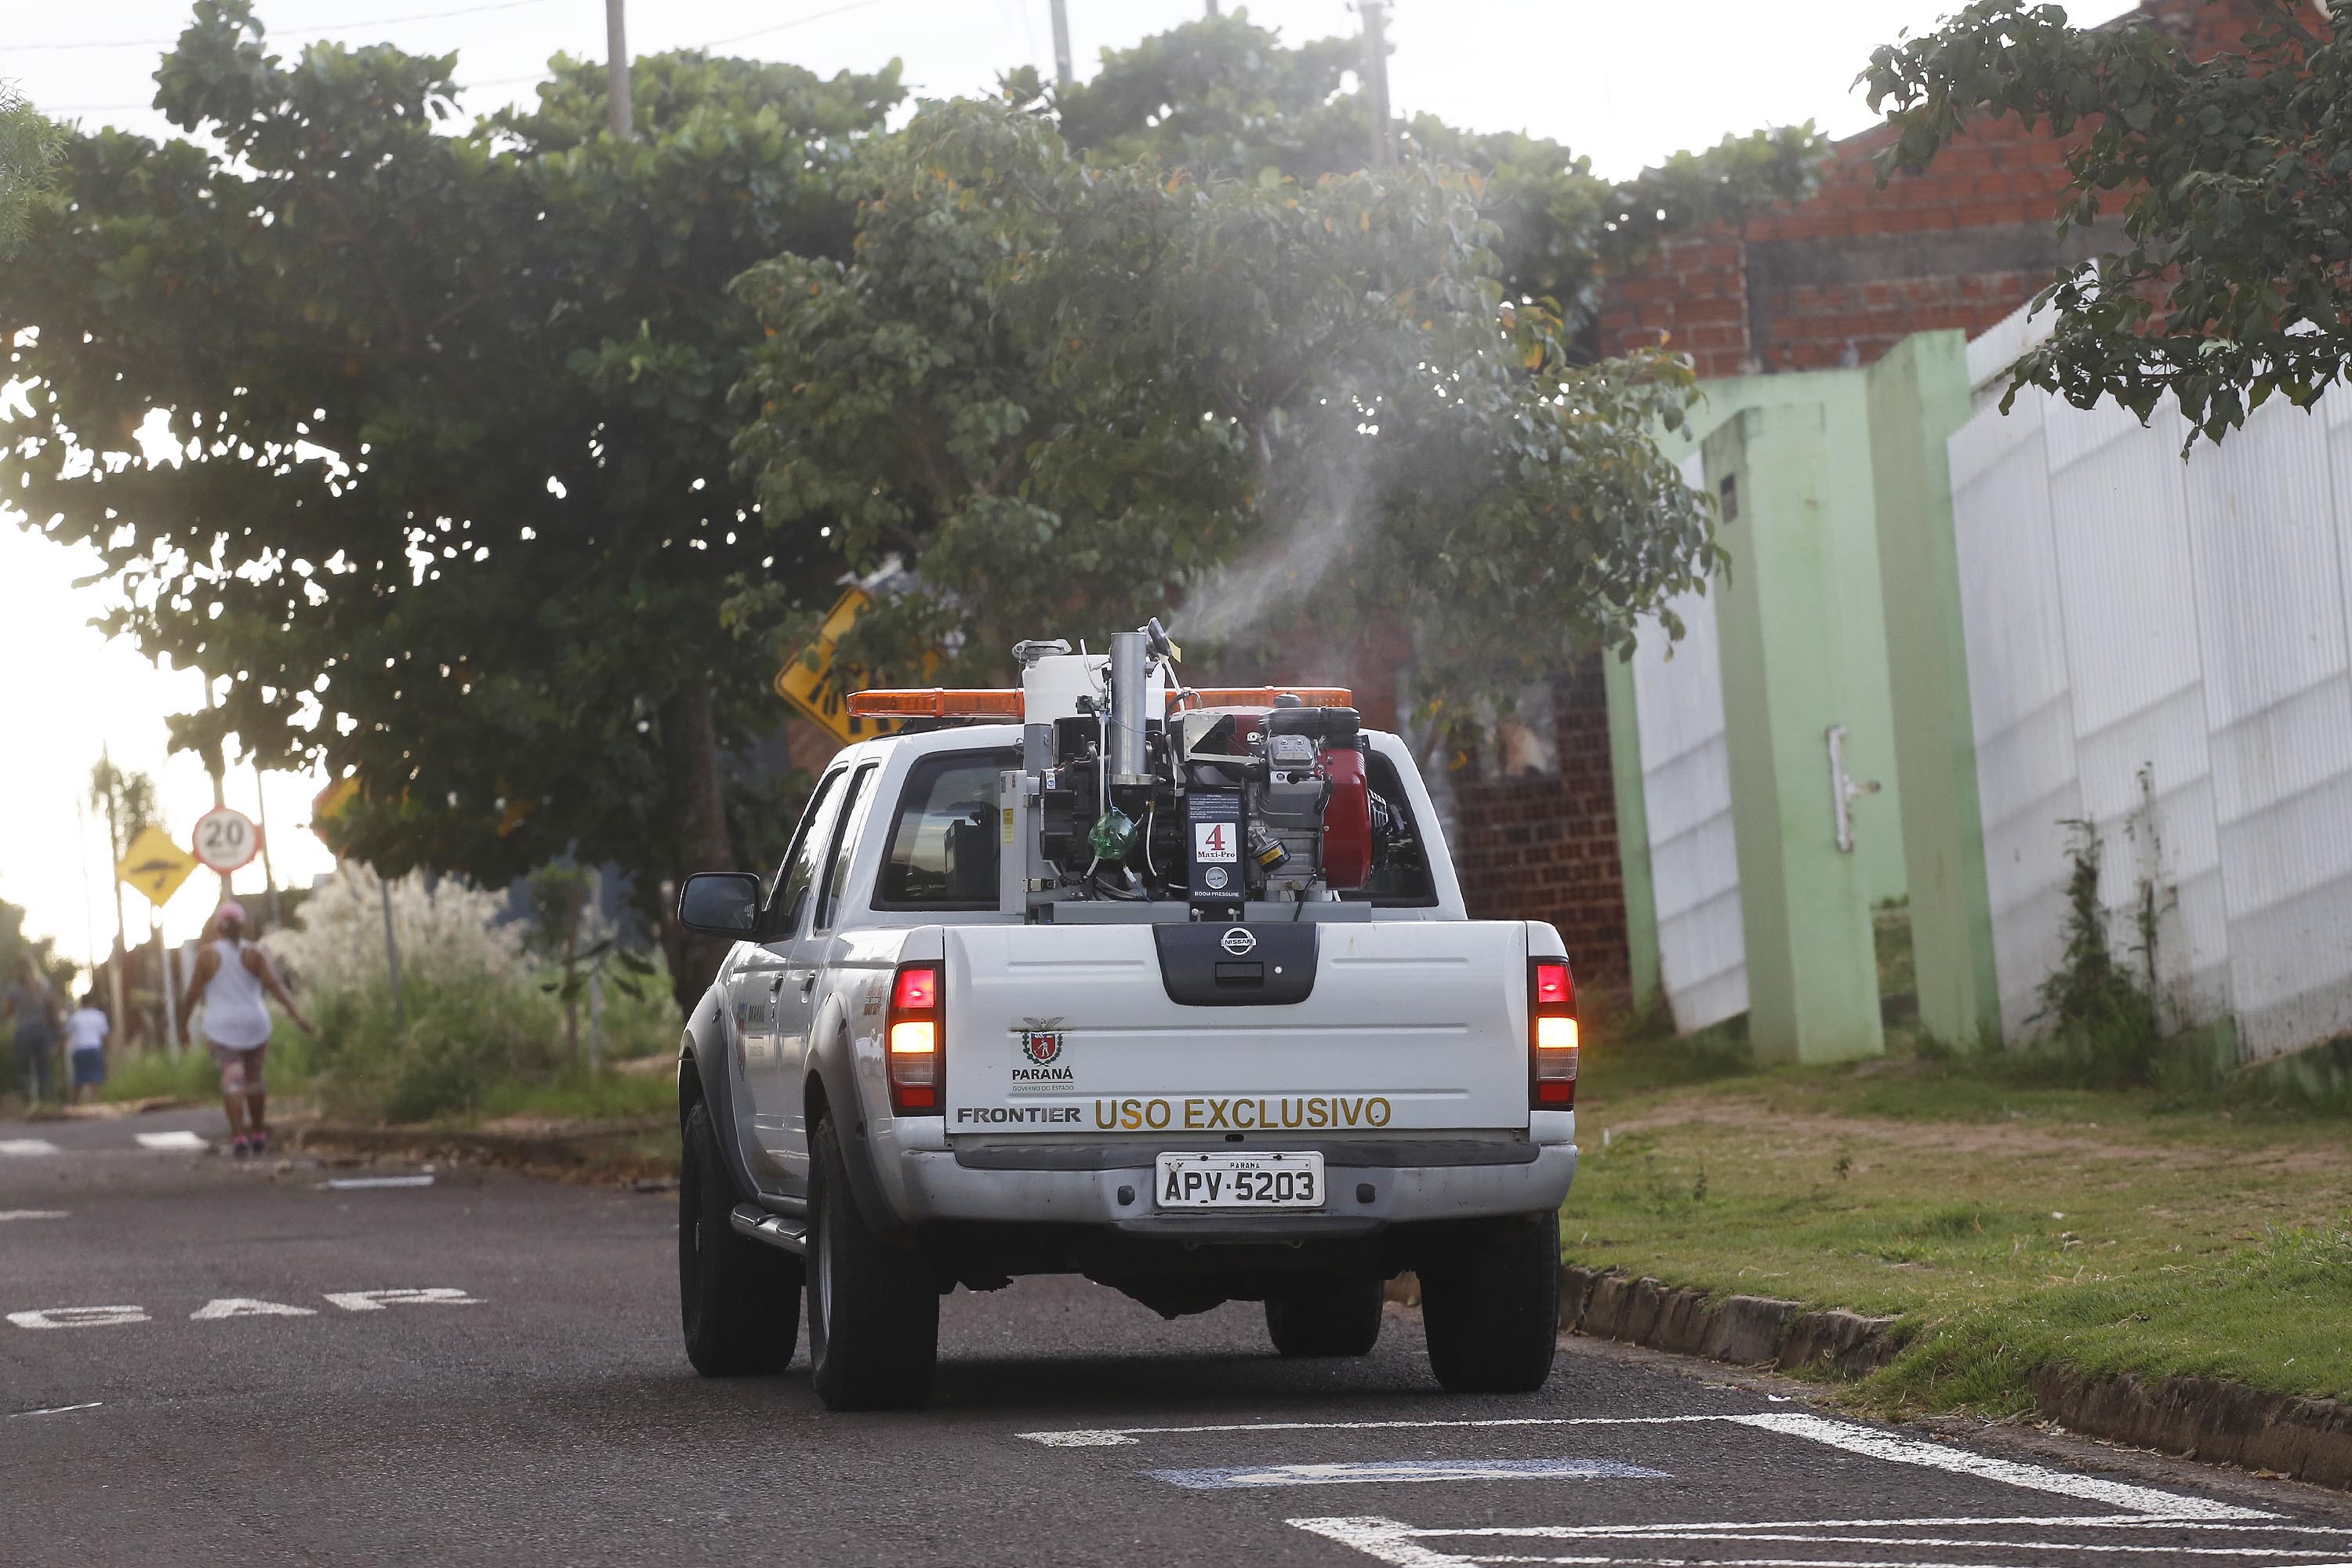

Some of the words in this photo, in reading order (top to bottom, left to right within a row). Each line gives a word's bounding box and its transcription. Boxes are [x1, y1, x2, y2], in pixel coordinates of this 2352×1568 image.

[205, 819, 244, 848] 20
[1205, 824, 1225, 851] 4
[1012, 1066, 1073, 1080] PARANÁ
[957, 1107, 1082, 1123] FRONTIER
[1095, 1098, 1171, 1130] USO
[1184, 1098, 1392, 1128] EXCLUSIVO
